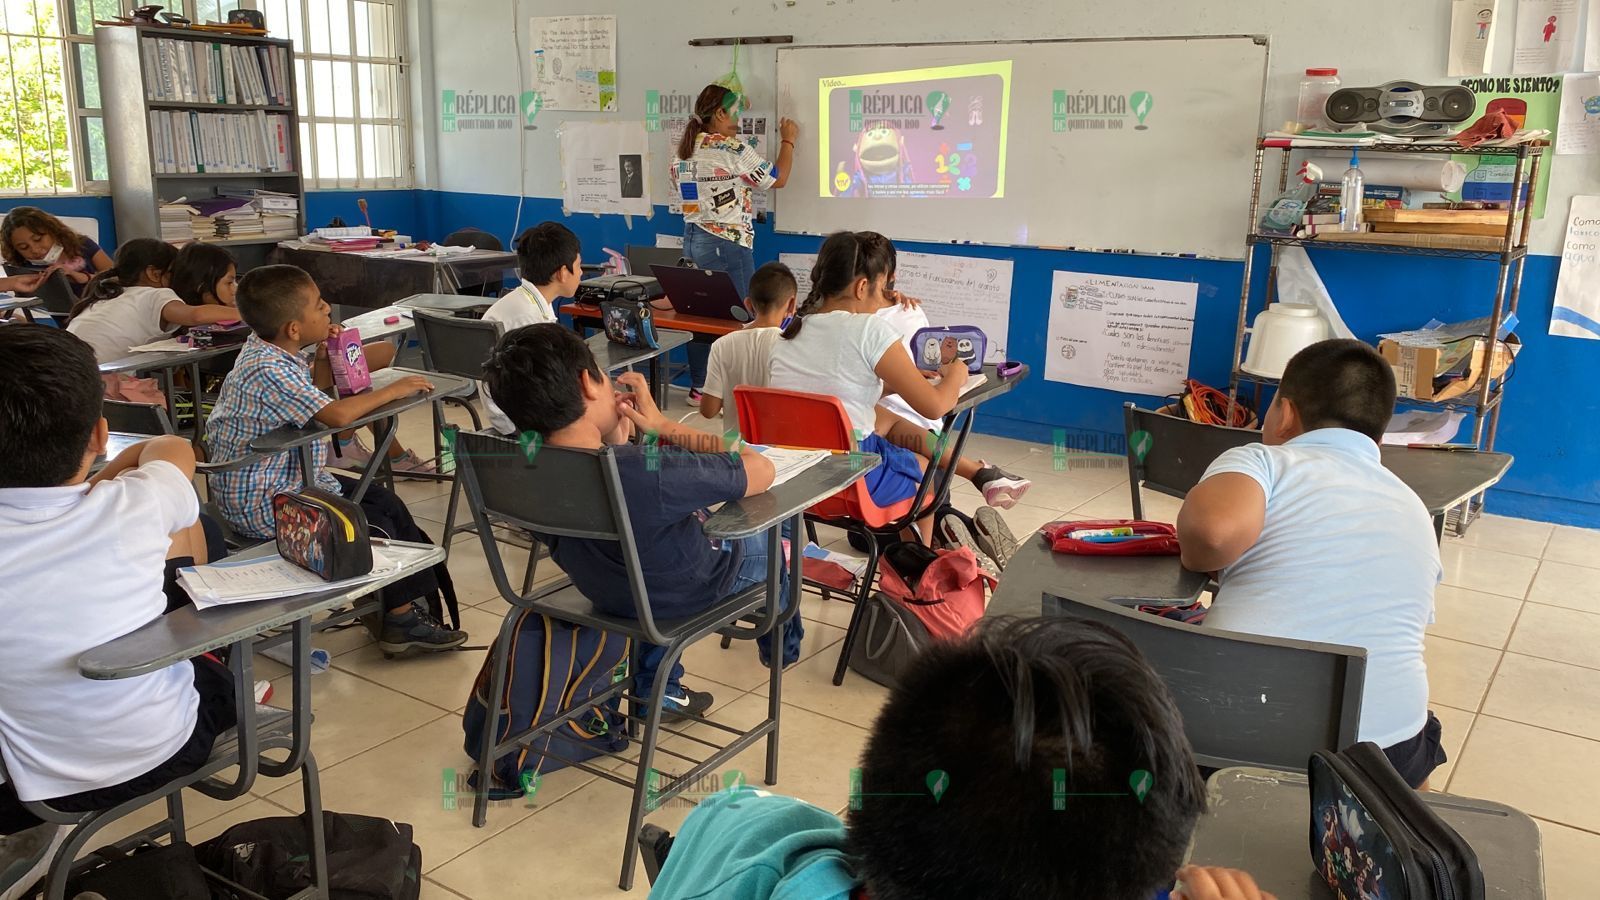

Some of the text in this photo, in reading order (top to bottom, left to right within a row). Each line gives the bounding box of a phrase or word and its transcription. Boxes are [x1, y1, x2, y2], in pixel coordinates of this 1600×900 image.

[1497, 78, 1511, 93] ME
[1513, 77, 1560, 93] SIENTO?
[1567, 241, 1595, 250] Como
